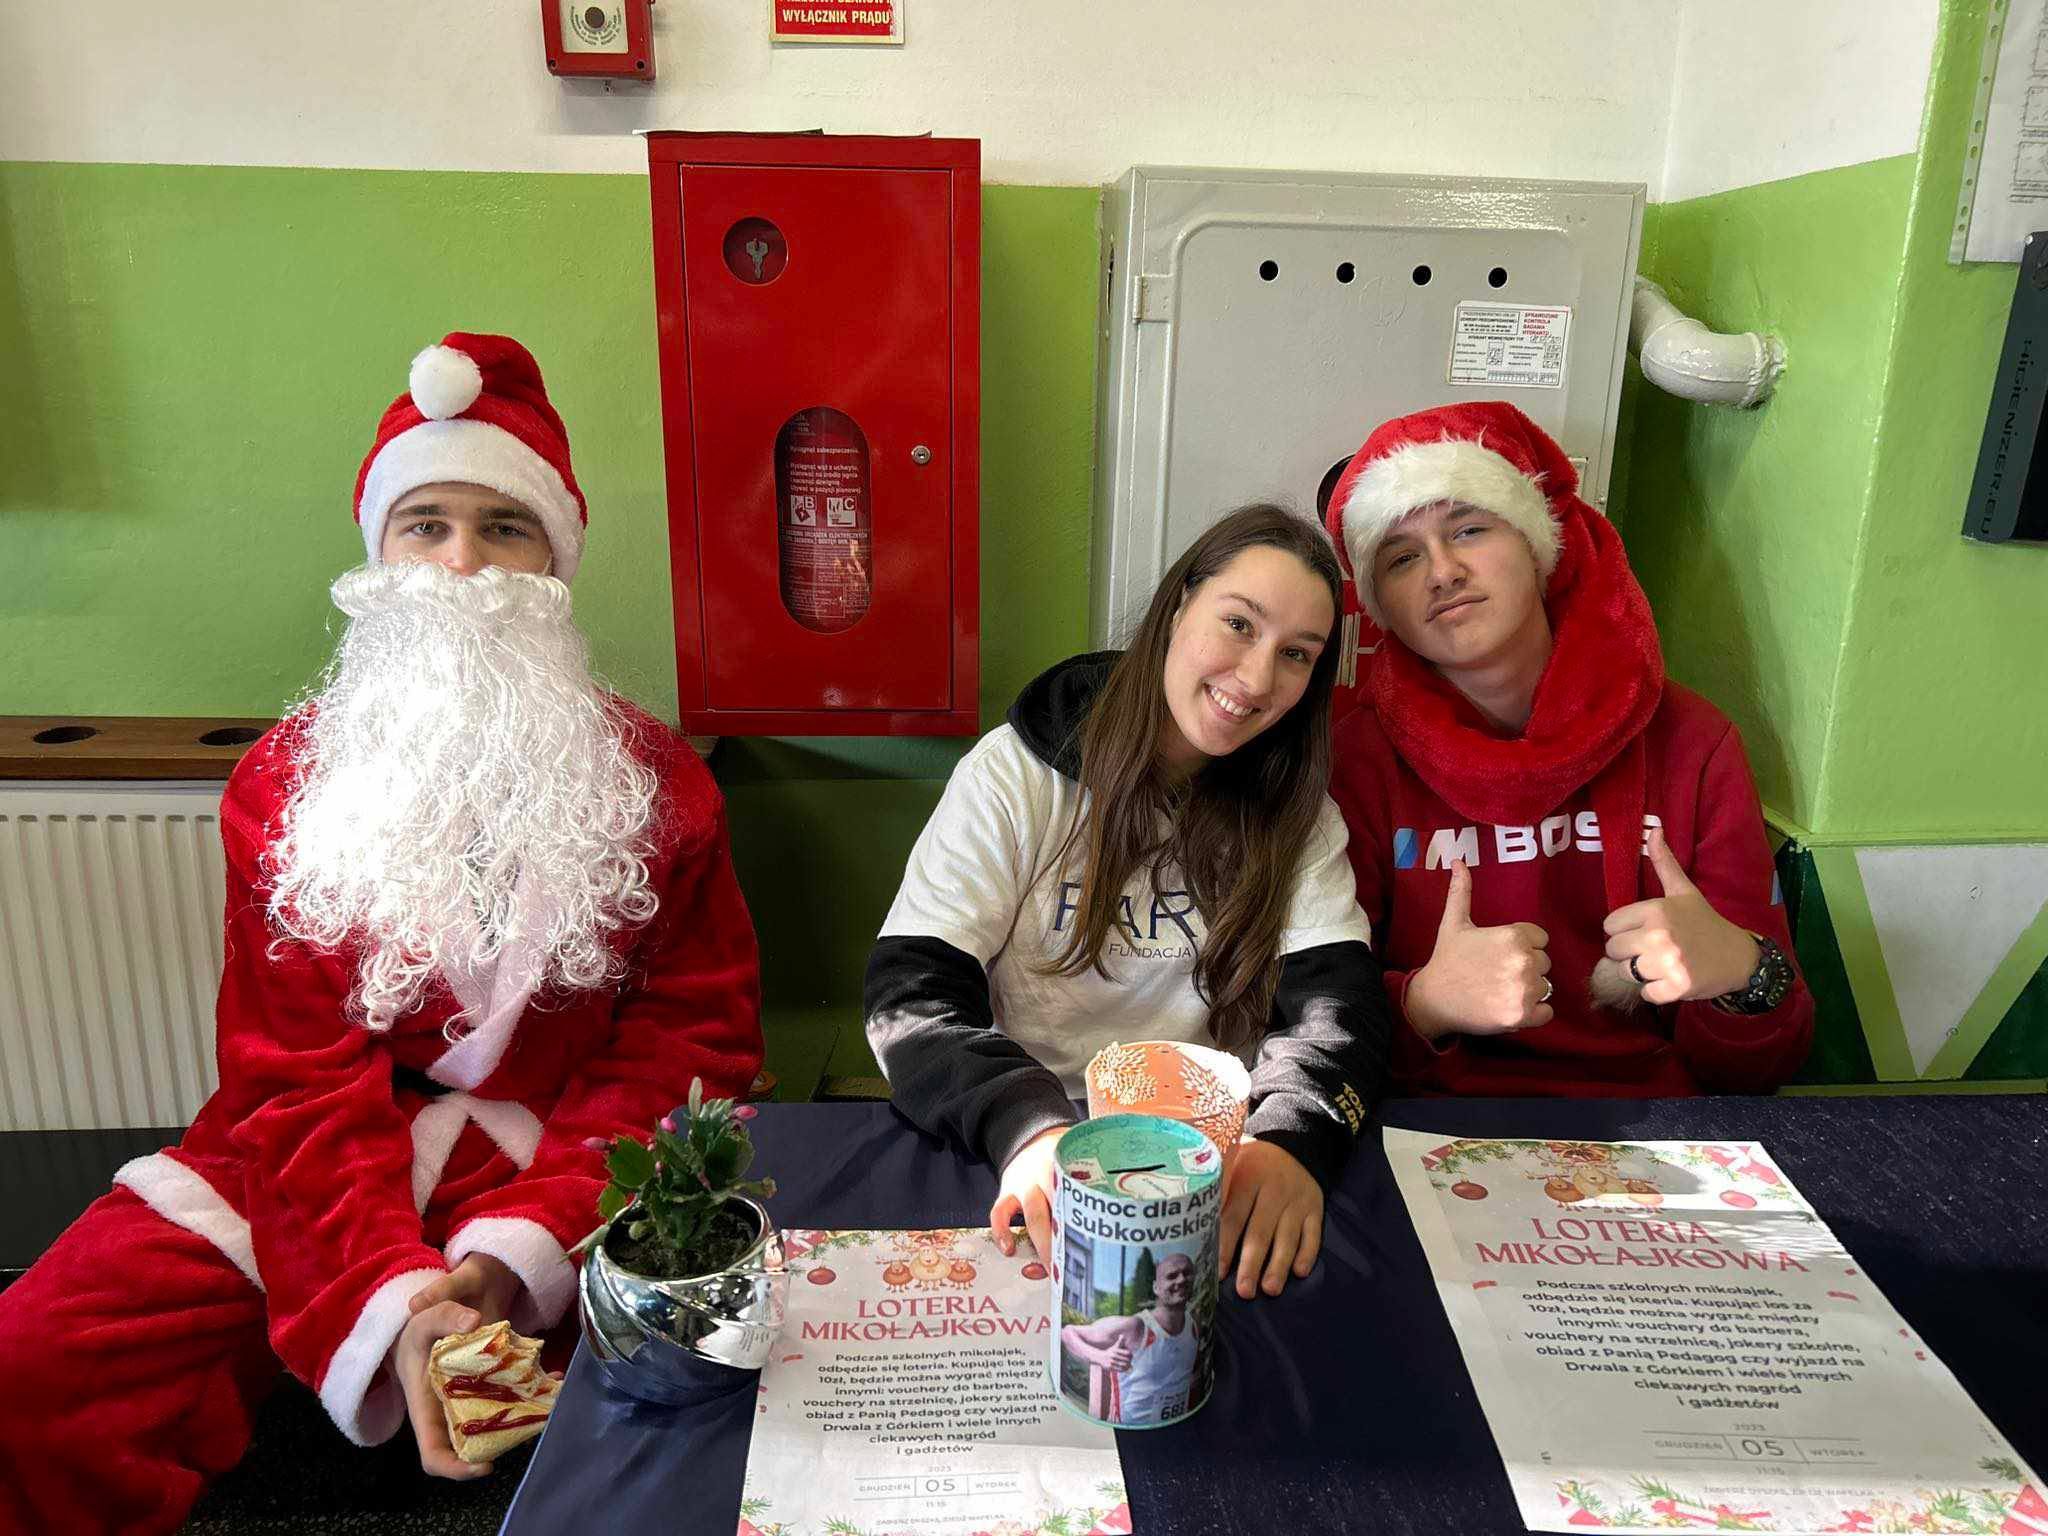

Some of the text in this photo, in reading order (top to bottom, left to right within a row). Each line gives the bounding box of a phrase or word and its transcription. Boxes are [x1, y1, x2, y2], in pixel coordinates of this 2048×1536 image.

[782, 9, 891, 26] WYŁĄCZNIK PRĄDU
[805, 497, 815, 509] B
[844, 498, 855, 510] C
[1425, 826, 1480, 871] M
[1108, 943, 1193, 959] FUNDACJA
[1062, 1177, 1137, 1218] Pomoc
[1142, 1198, 1182, 1219] dla
[1530, 1216, 1723, 1245] LOTERIA
[1475, 1242, 1809, 1273] MIKOŁAJKOWA
[1537, 1280, 1782, 1298] Podczas szkolnych mikołajek,
[856, 1295, 1002, 1318] LOTERIA
[1522, 1293, 1598, 1304] odbędzie
[1602, 1293, 1625, 1305] się
[1629, 1295, 1687, 1306] loteria.
[1692, 1298, 1758, 1311] Kupując
[1762, 1300, 1789, 1309] los
[1530, 1304, 1820, 1325] 10zł, będzie można wygrać między
[800, 1315, 1052, 1341] MIKOŁAJKOWA
[1557, 1317, 1811, 1337] innymi: vouchery do barbera,
[1524, 1331, 1861, 1354] vouchery na strzelnicę, jokery szkolne,
[836, 1347, 1026, 1362] Podczas szkolnych mikołajek,
[1535, 1346, 1586, 1357] obiad
[1604, 1348, 1653, 1361] Panią
[1658, 1351, 1738, 1365] Pedagog
[1742, 1357, 1770, 1367] czy
[1774, 1356, 1839, 1369] wyjazd
[1843, 1359, 1865, 1367] na
[818, 1364, 878, 1375] odbędzie
[881, 1363, 900, 1374] się
[903, 1361, 949, 1371] loteria.
[951, 1358, 1003, 1370] Kupując
[1007, 1358, 1026, 1367] los
[1565, 1361, 1629, 1374] Drwala
[1647, 1364, 1724, 1377] Górkiem
[1728, 1367, 1734, 1377] i
[1738, 1369, 1786, 1380] wiele
[1791, 1370, 1853, 1383] innych
[818, 1369, 1043, 1386] 10zł, będzie można wygrać między
[835, 1382, 1028, 1396] innymi: vouchery do barbera,
[1634, 1379, 1803, 1396] ciekawych nagród
[803, 1398, 865, 1409] vouchery
[889, 1395, 958, 1406] strzelnicę,
[961, 1393, 1002, 1405] jokery
[1677, 1395, 1780, 1411] i gadżetów
[806, 1410, 844, 1420] obiad
[859, 1410, 896, 1420] Panią
[900, 1407, 960, 1418] Pedagog
[964, 1407, 987, 1416] czy
[991, 1404, 1037, 1415] wyjazd
[1041, 1405, 1057, 1413] na
[823, 1422, 871, 1432] Drwala
[886, 1420, 944, 1431] Górkiem
[956, 1417, 991, 1428] wiele
[995, 1416, 1041, 1426] innych
[869, 1430, 996, 1444] ciekawych nagród
[904, 1444, 974, 1456] gadżetów
[1742, 1439, 1784, 1456] 05
[925, 1479, 956, 1493] 05
[975, 1481, 1017, 1489] WTOREK
